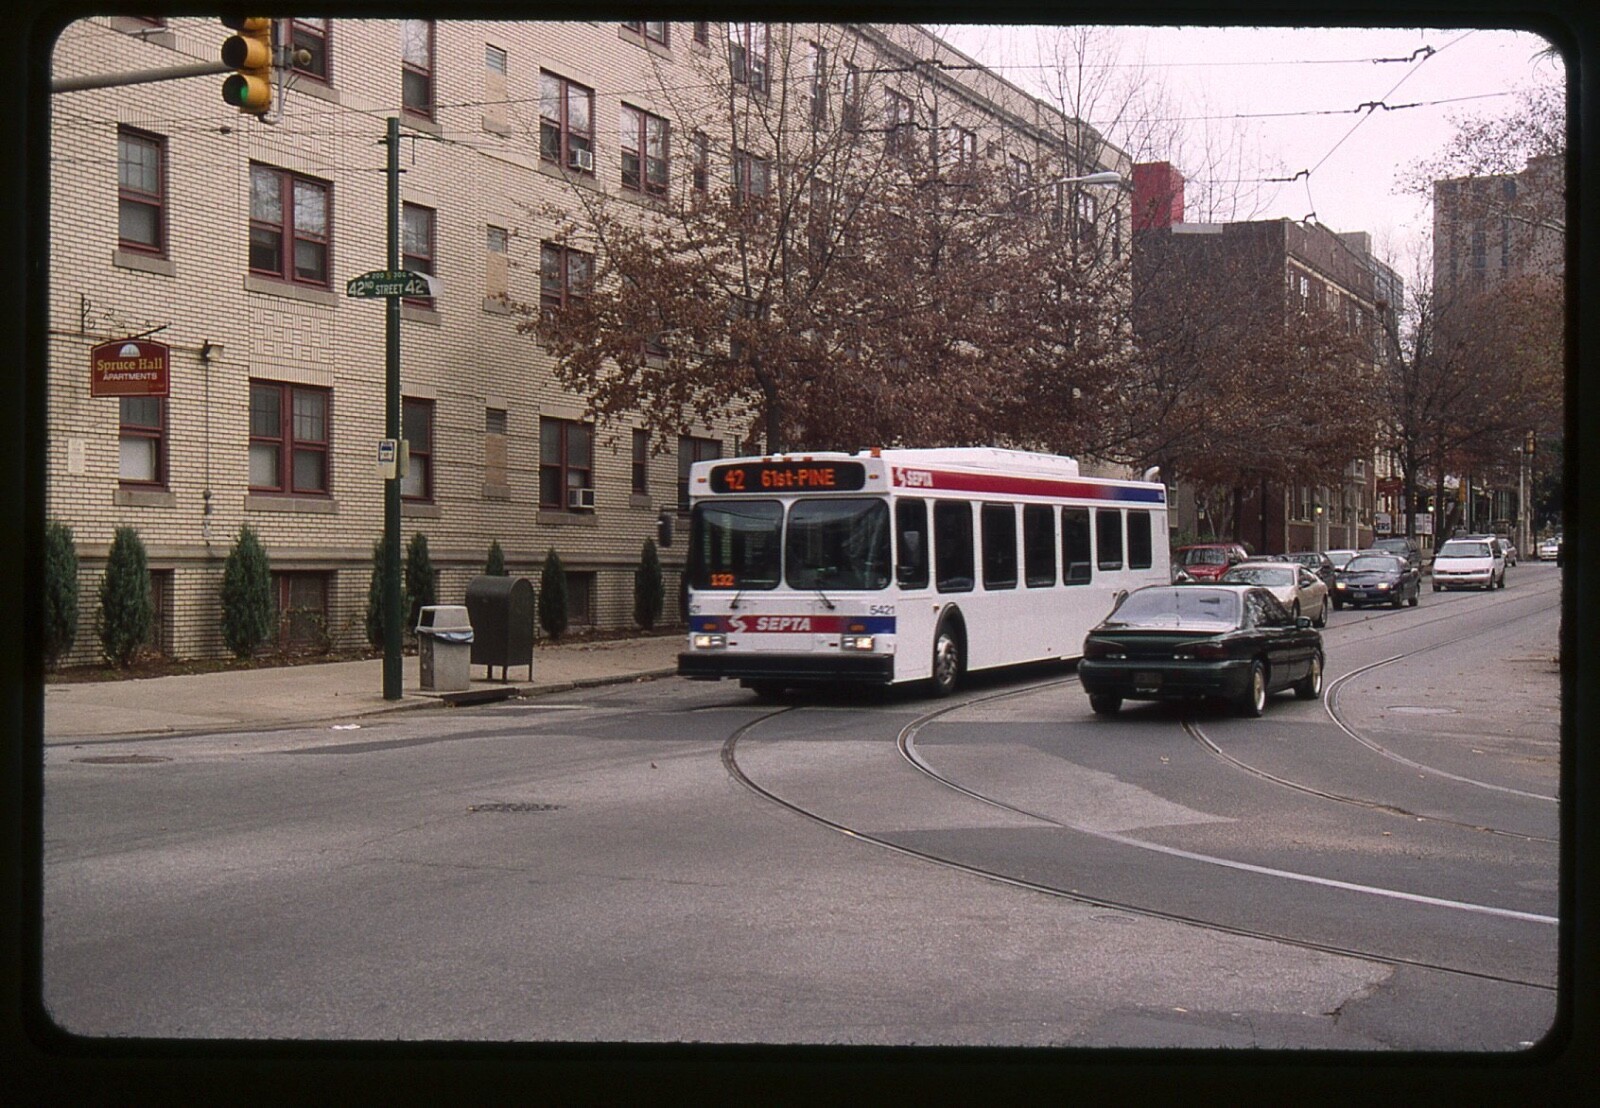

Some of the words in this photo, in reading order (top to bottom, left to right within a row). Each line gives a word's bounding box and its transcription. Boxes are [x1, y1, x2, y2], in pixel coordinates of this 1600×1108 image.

[375, 283, 403, 295] STREET
[97, 359, 136, 372] Spruce
[139, 357, 163, 370] Hall
[103, 372, 157, 380] APARTMENTS
[724, 469, 745, 490] 42
[761, 468, 835, 487] 61st-PINE
[907, 471, 934, 487] SEPTA
[711, 573, 735, 586] 132
[869, 604, 895, 615] 5421
[756, 617, 811, 631] SEPTA
